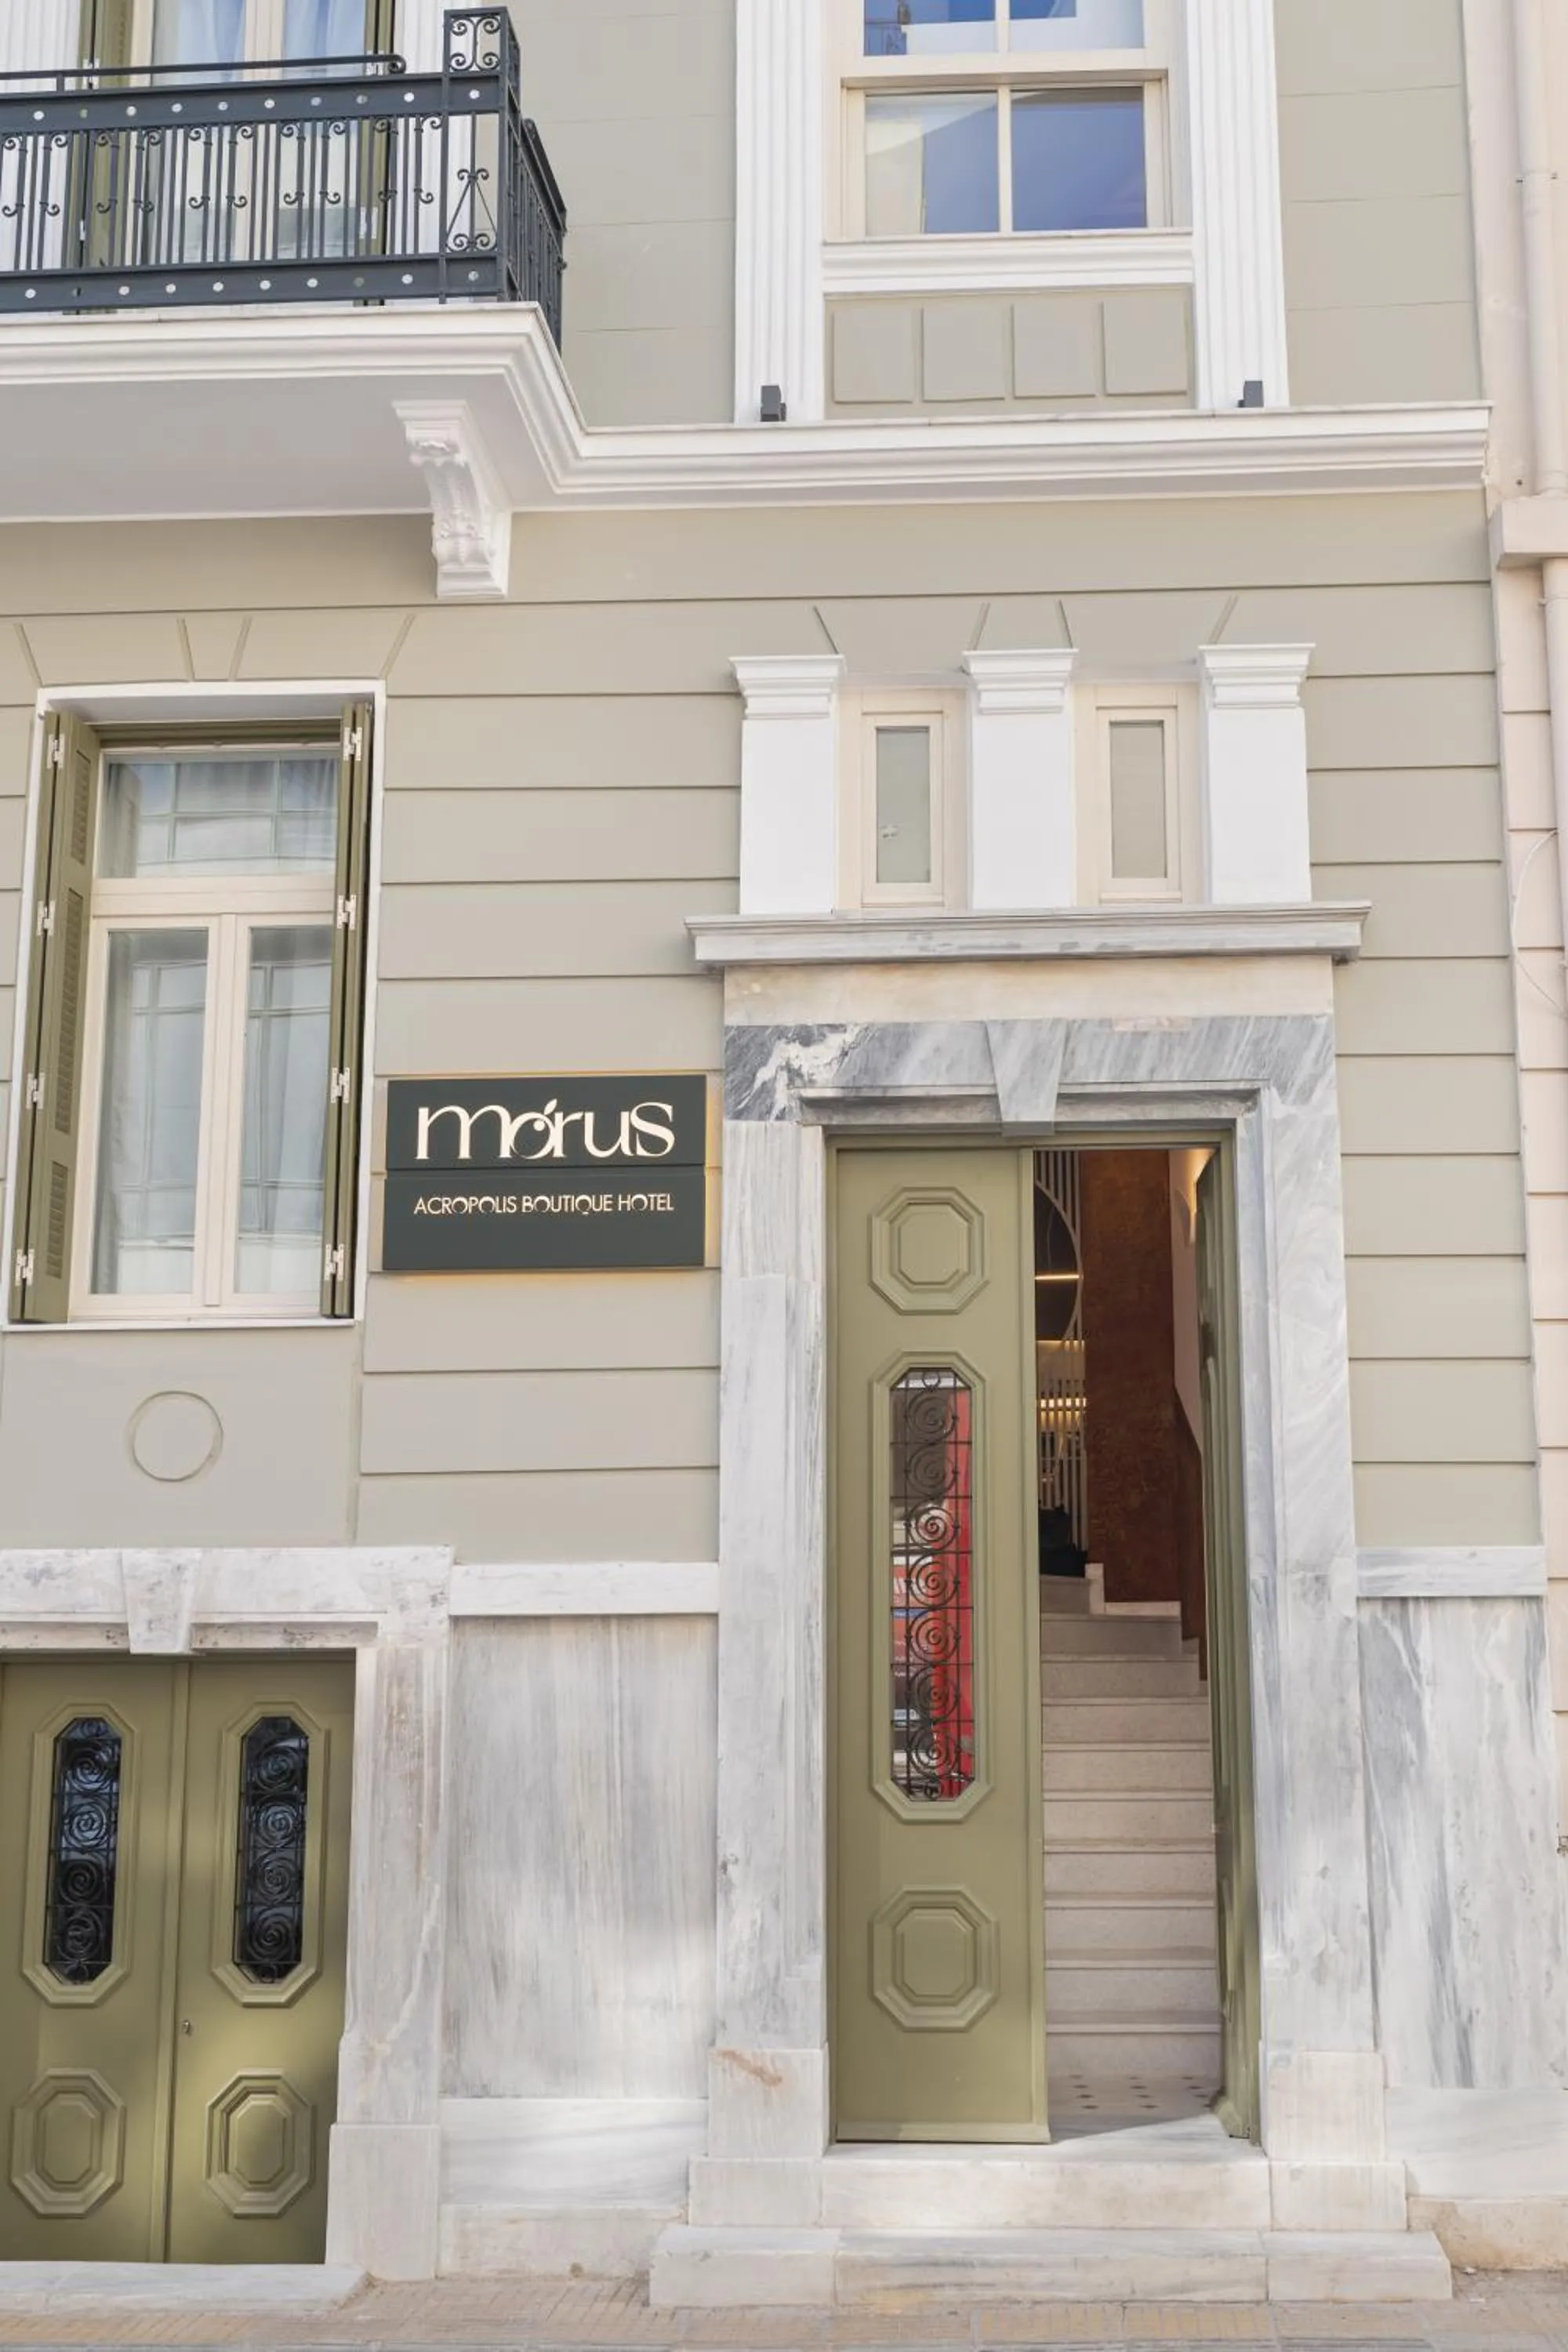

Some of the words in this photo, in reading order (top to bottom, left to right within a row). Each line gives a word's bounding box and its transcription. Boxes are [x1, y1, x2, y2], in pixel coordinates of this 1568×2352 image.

[414, 1196, 517, 1214] ACROPOLIS
[522, 1194, 613, 1214] BOUTIQUE
[618, 1193, 675, 1211] HOTEL
